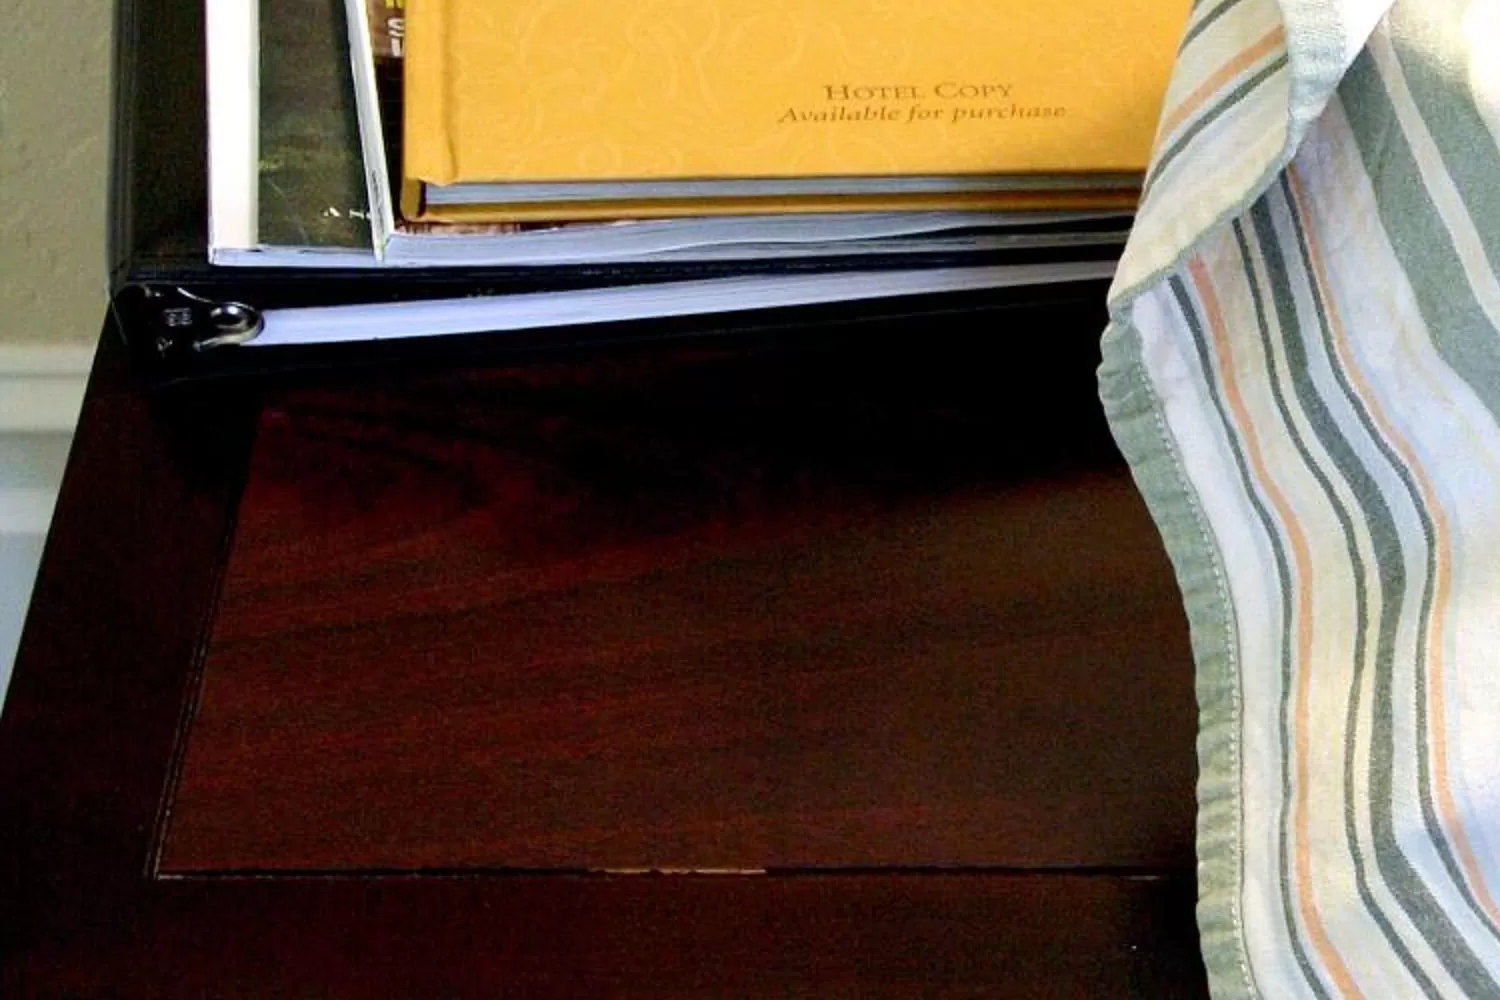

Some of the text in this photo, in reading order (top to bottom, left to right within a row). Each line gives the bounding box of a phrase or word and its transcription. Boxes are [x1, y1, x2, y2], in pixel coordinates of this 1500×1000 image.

[824, 82, 1014, 101] HOTEL COPY
[777, 103, 1067, 124] Available for purchase
